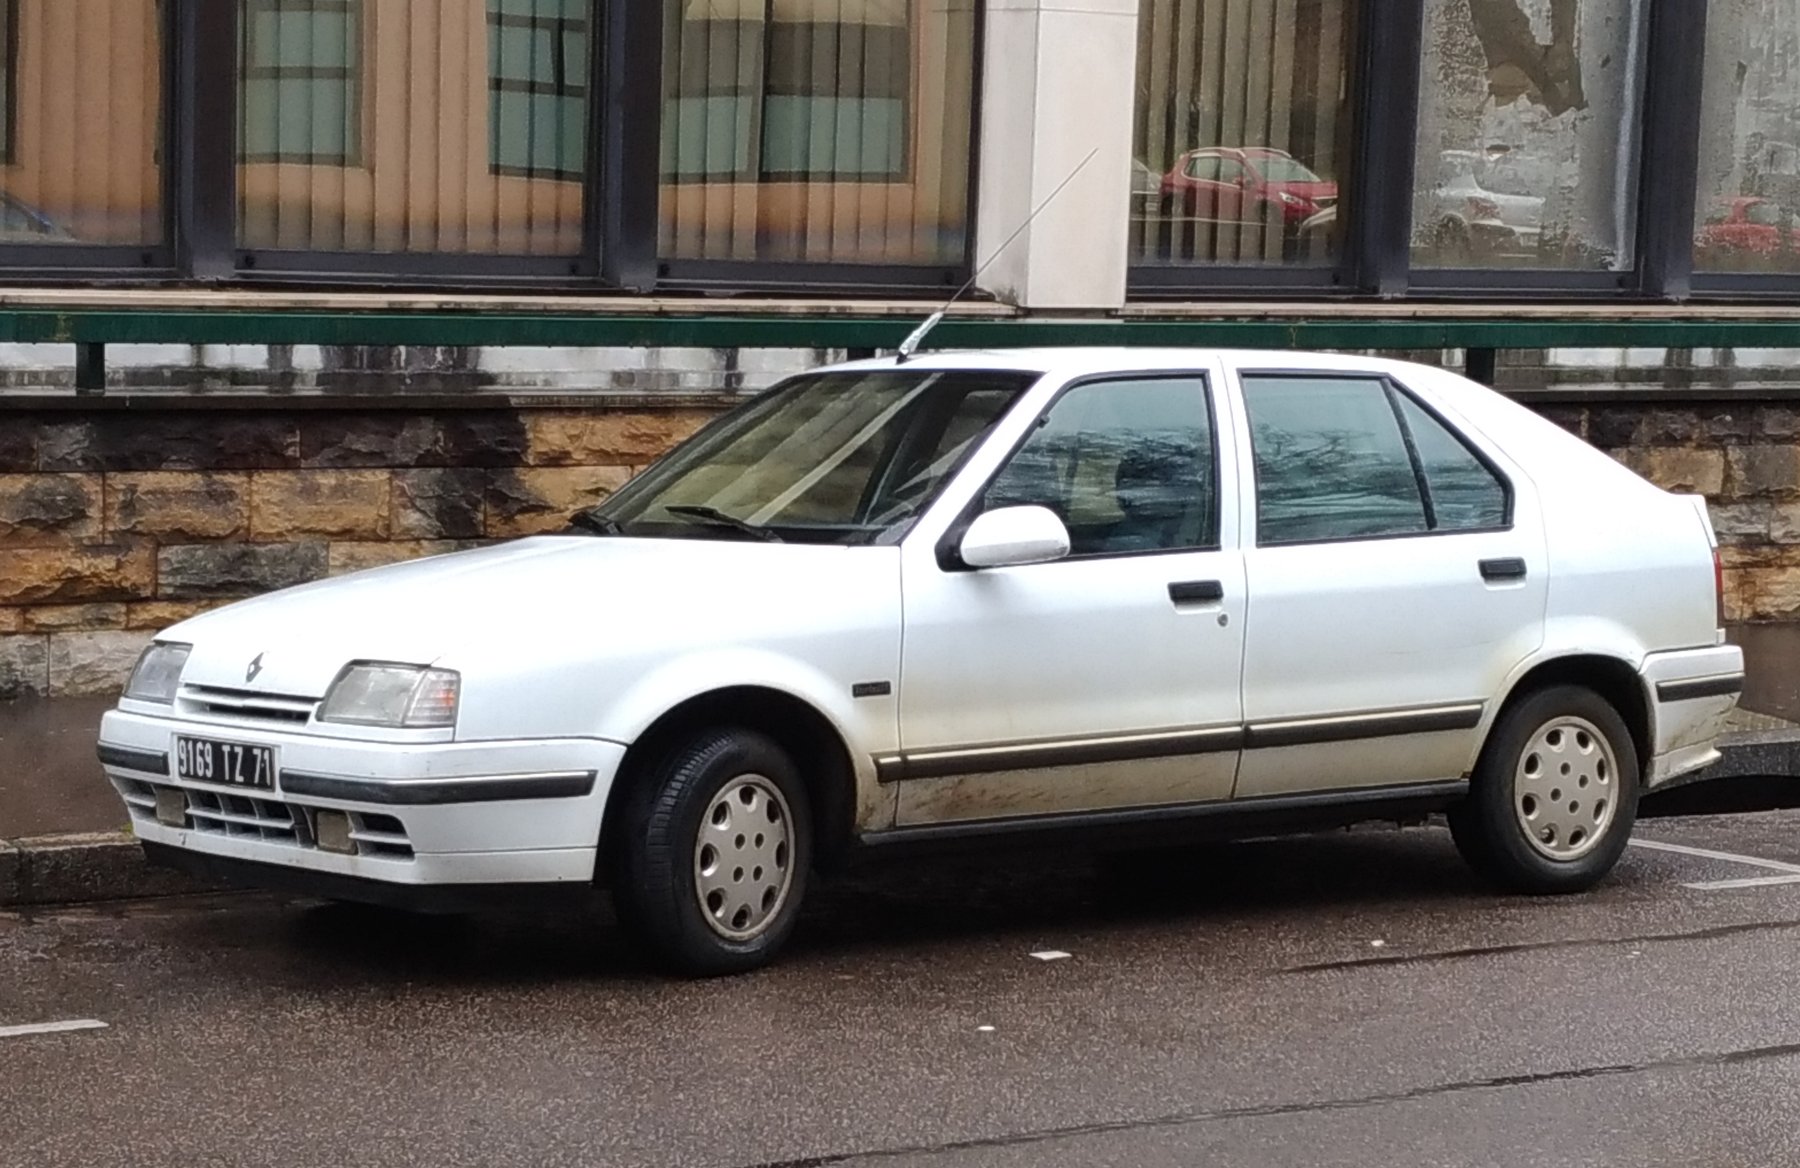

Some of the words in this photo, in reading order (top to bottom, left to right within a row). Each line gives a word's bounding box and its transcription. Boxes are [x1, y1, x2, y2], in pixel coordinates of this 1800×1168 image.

[179, 739, 213, 778] 9169
[222, 745, 244, 782] TZ
[253, 748, 271, 786] 71
